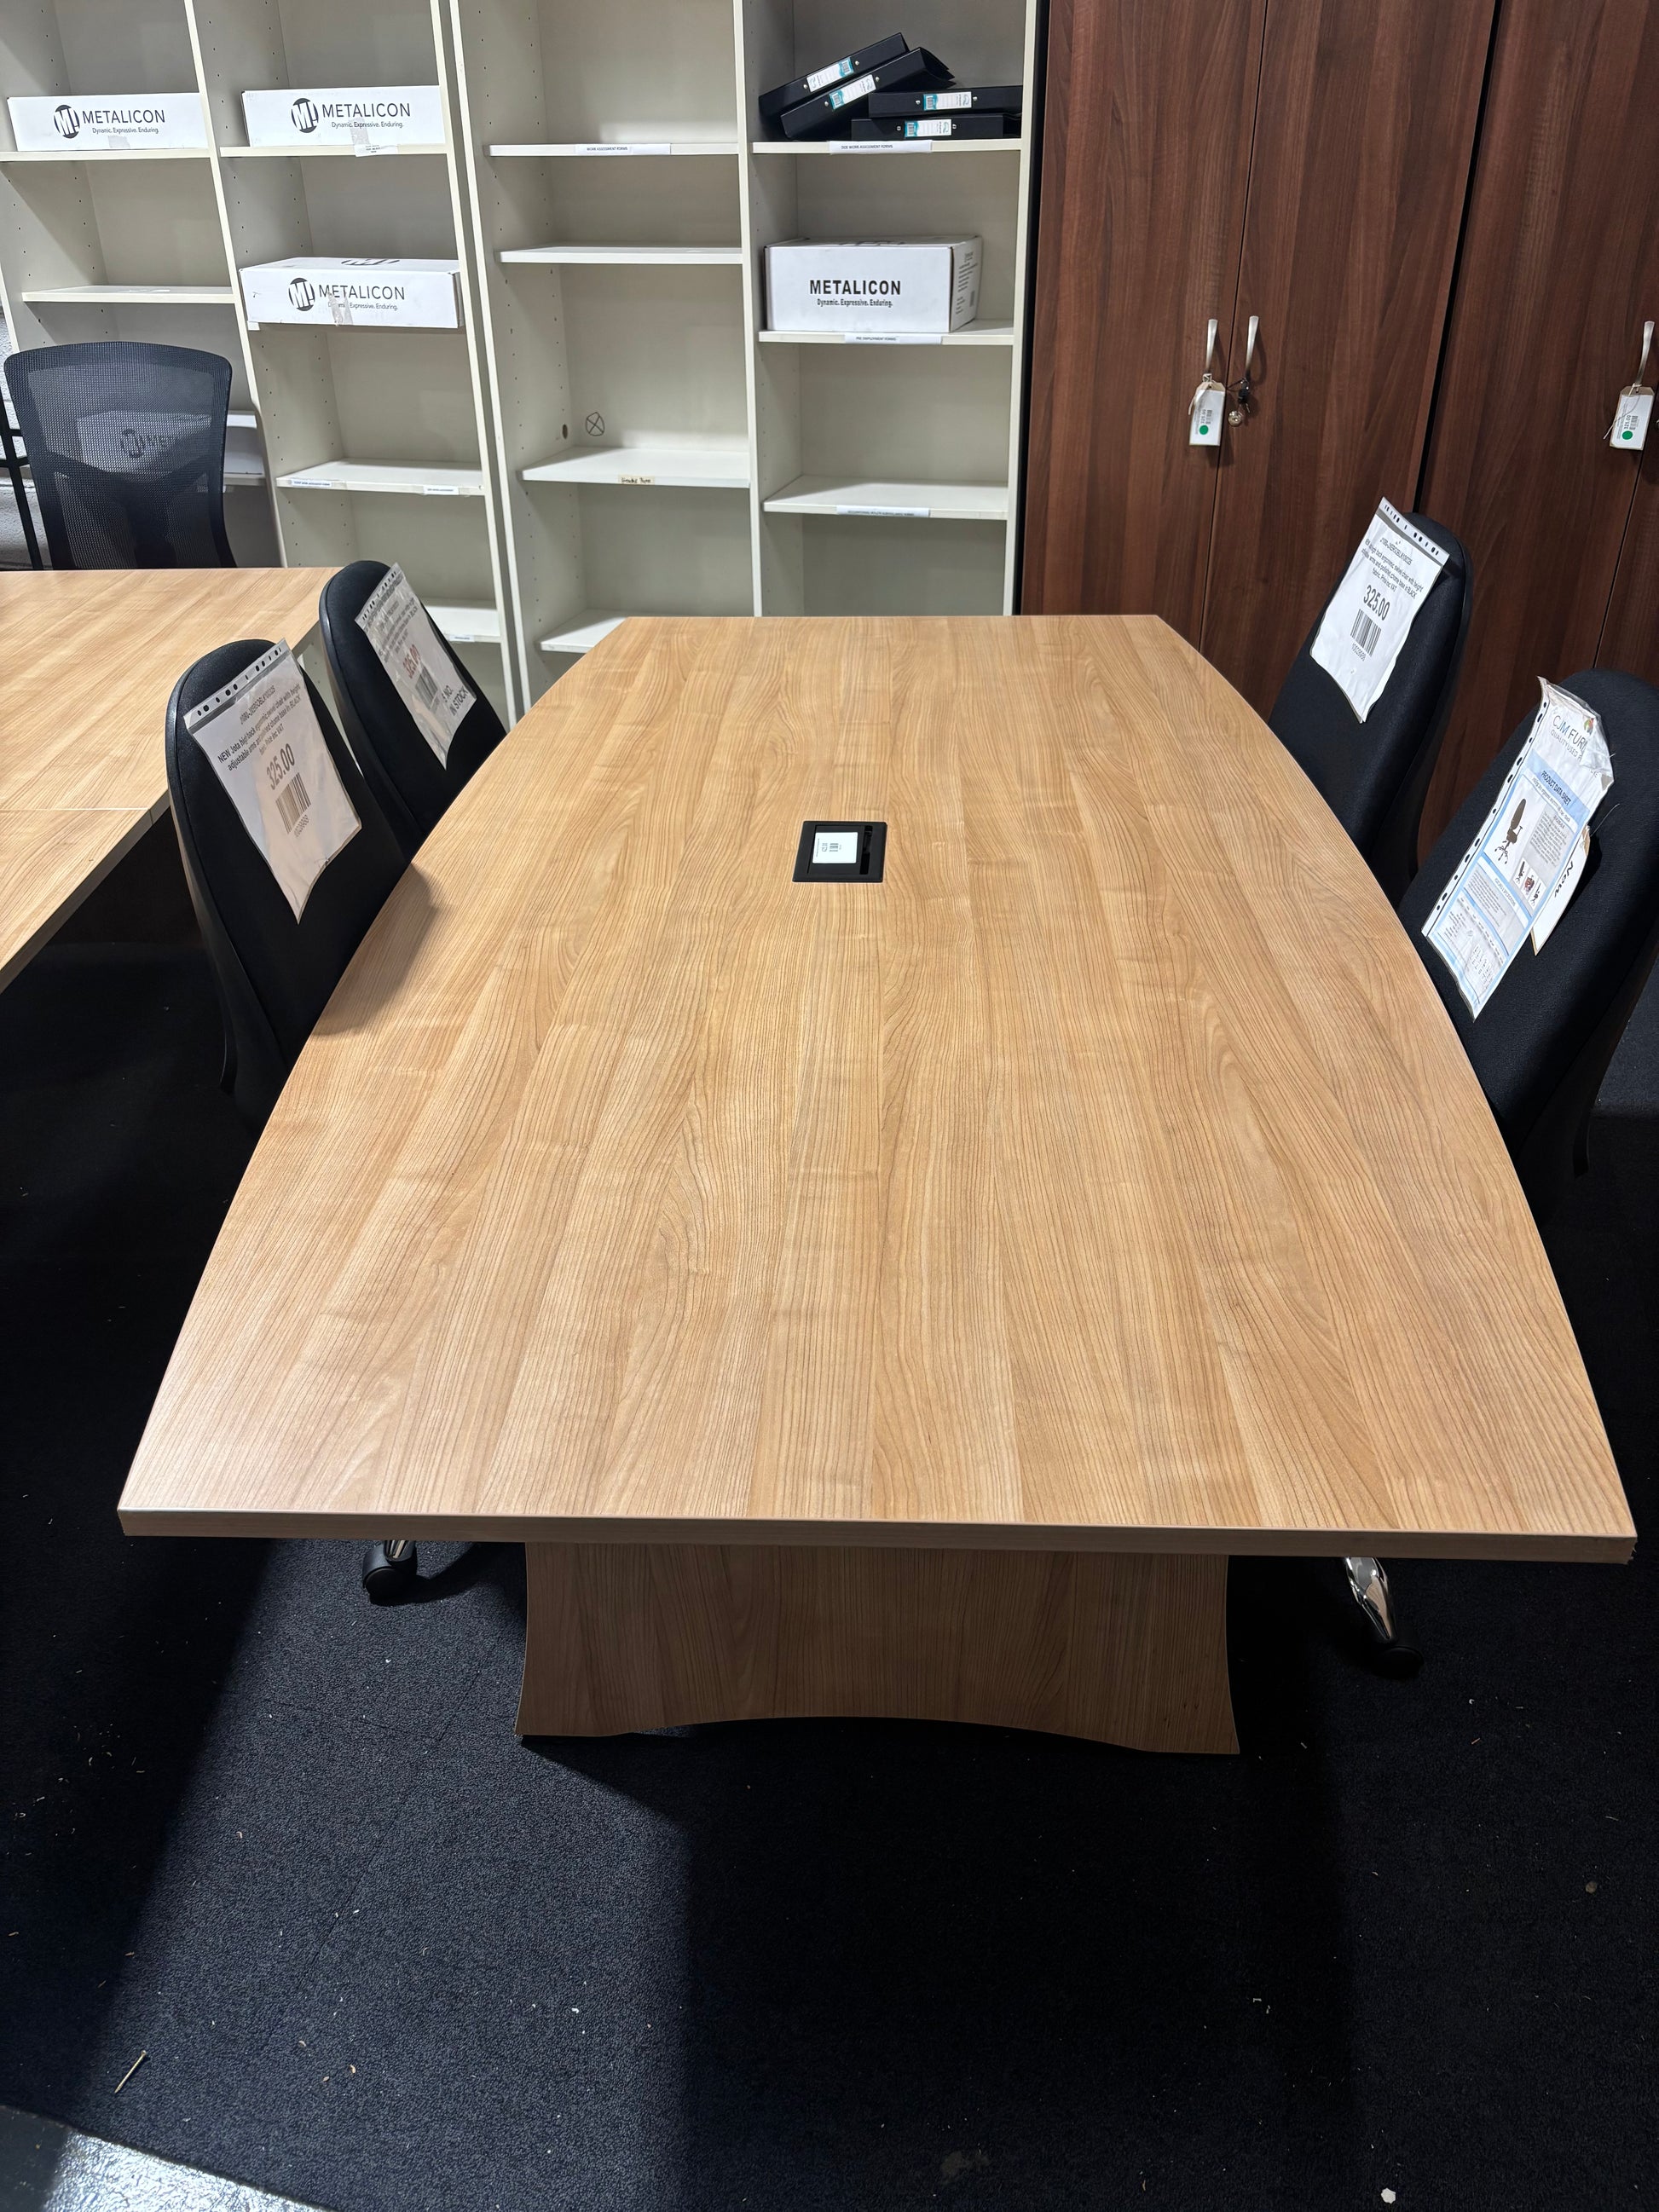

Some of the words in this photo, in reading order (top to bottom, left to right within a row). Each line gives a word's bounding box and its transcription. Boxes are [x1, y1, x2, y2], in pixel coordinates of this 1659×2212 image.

[82, 109, 165, 124] METALICON
[322, 102, 411, 118] METALICON
[318, 284, 405, 300] METALICON
[809, 280, 901, 296] METALICON
[817, 298, 840, 307] Dynamic.
[841, 298, 869, 307] Expressive.
[870, 298, 893, 308] Enduring.
[1363, 584, 1390, 621] 325.00
[1552, 714, 1570, 734] CJM
[217, 748, 231, 763] NEW
[230, 742, 241, 754] Jota
[228, 749, 250, 771] adjustable
[267, 742, 295, 790] 325.00
